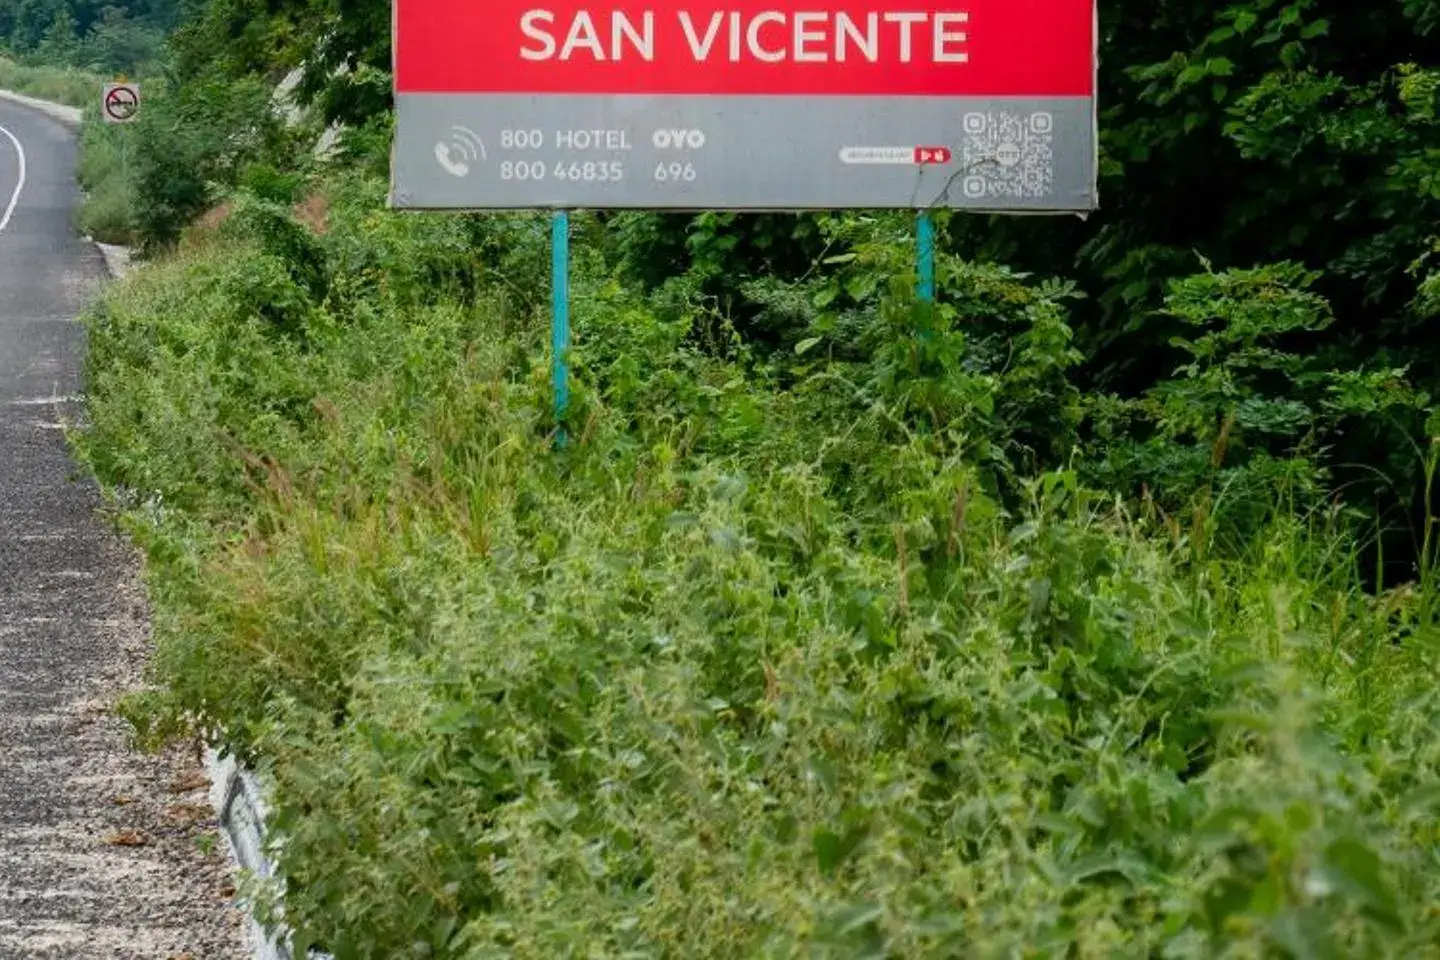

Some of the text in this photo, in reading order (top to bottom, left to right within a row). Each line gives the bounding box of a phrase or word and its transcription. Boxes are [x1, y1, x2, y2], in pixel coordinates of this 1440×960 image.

[519, 9, 969, 62] SAN VICENTE
[500, 129, 706, 150] 800 HOTEL OYO
[500, 161, 697, 181] 800 46835 696
